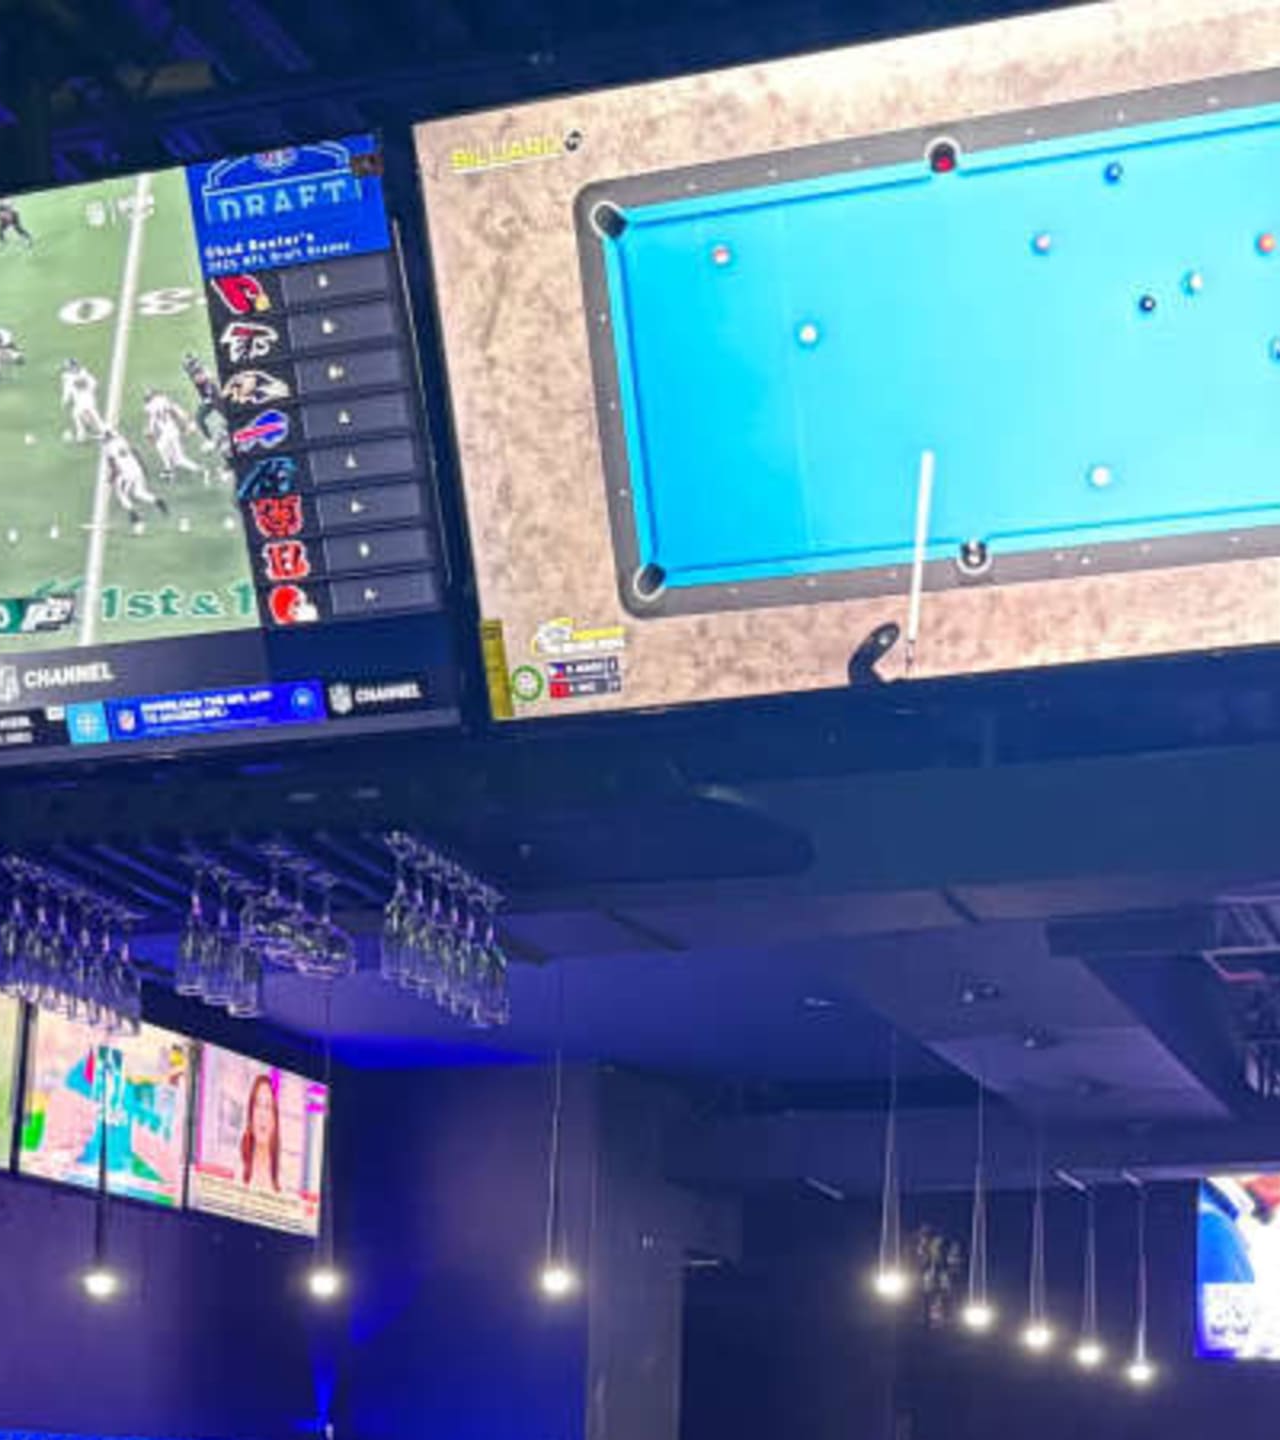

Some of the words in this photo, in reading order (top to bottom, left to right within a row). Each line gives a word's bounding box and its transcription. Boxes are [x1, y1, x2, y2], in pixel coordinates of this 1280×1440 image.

[218, 179, 348, 222] DRAFT
[102, 583, 183, 621] 1st
[190, 591, 223, 621] &
[24, 661, 114, 689] CHANNEL
[355, 682, 422, 704] CHANNEL
